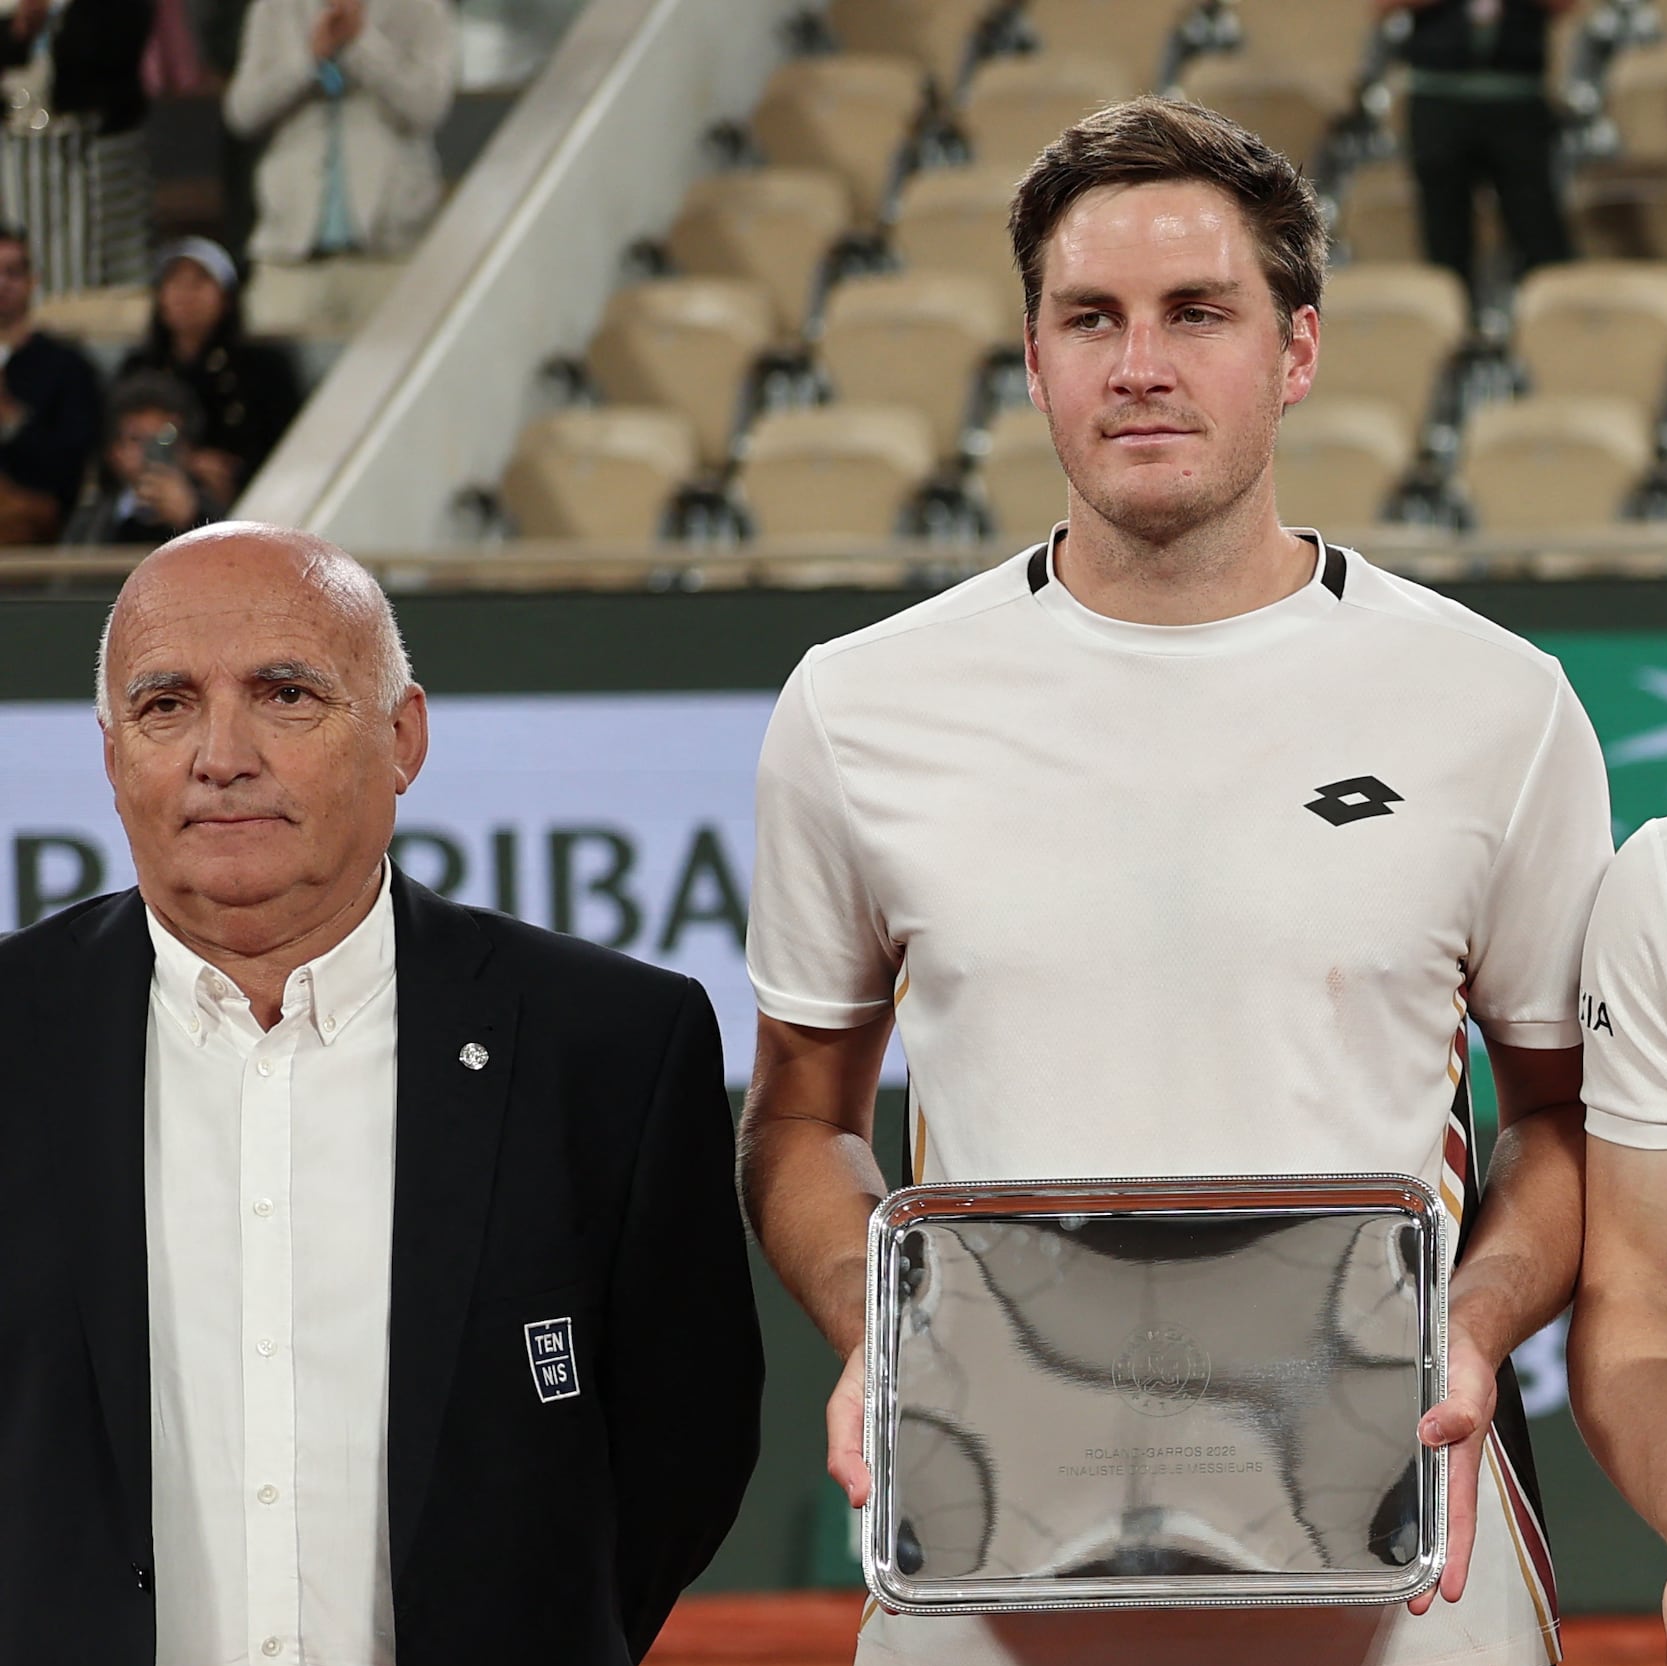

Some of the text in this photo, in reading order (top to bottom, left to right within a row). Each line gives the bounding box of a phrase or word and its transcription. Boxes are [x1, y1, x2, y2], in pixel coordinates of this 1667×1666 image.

[534, 1331, 564, 1355] TEN
[541, 1363, 567, 1387] NIS
[1057, 1464, 1124, 1477] FINALISTE
